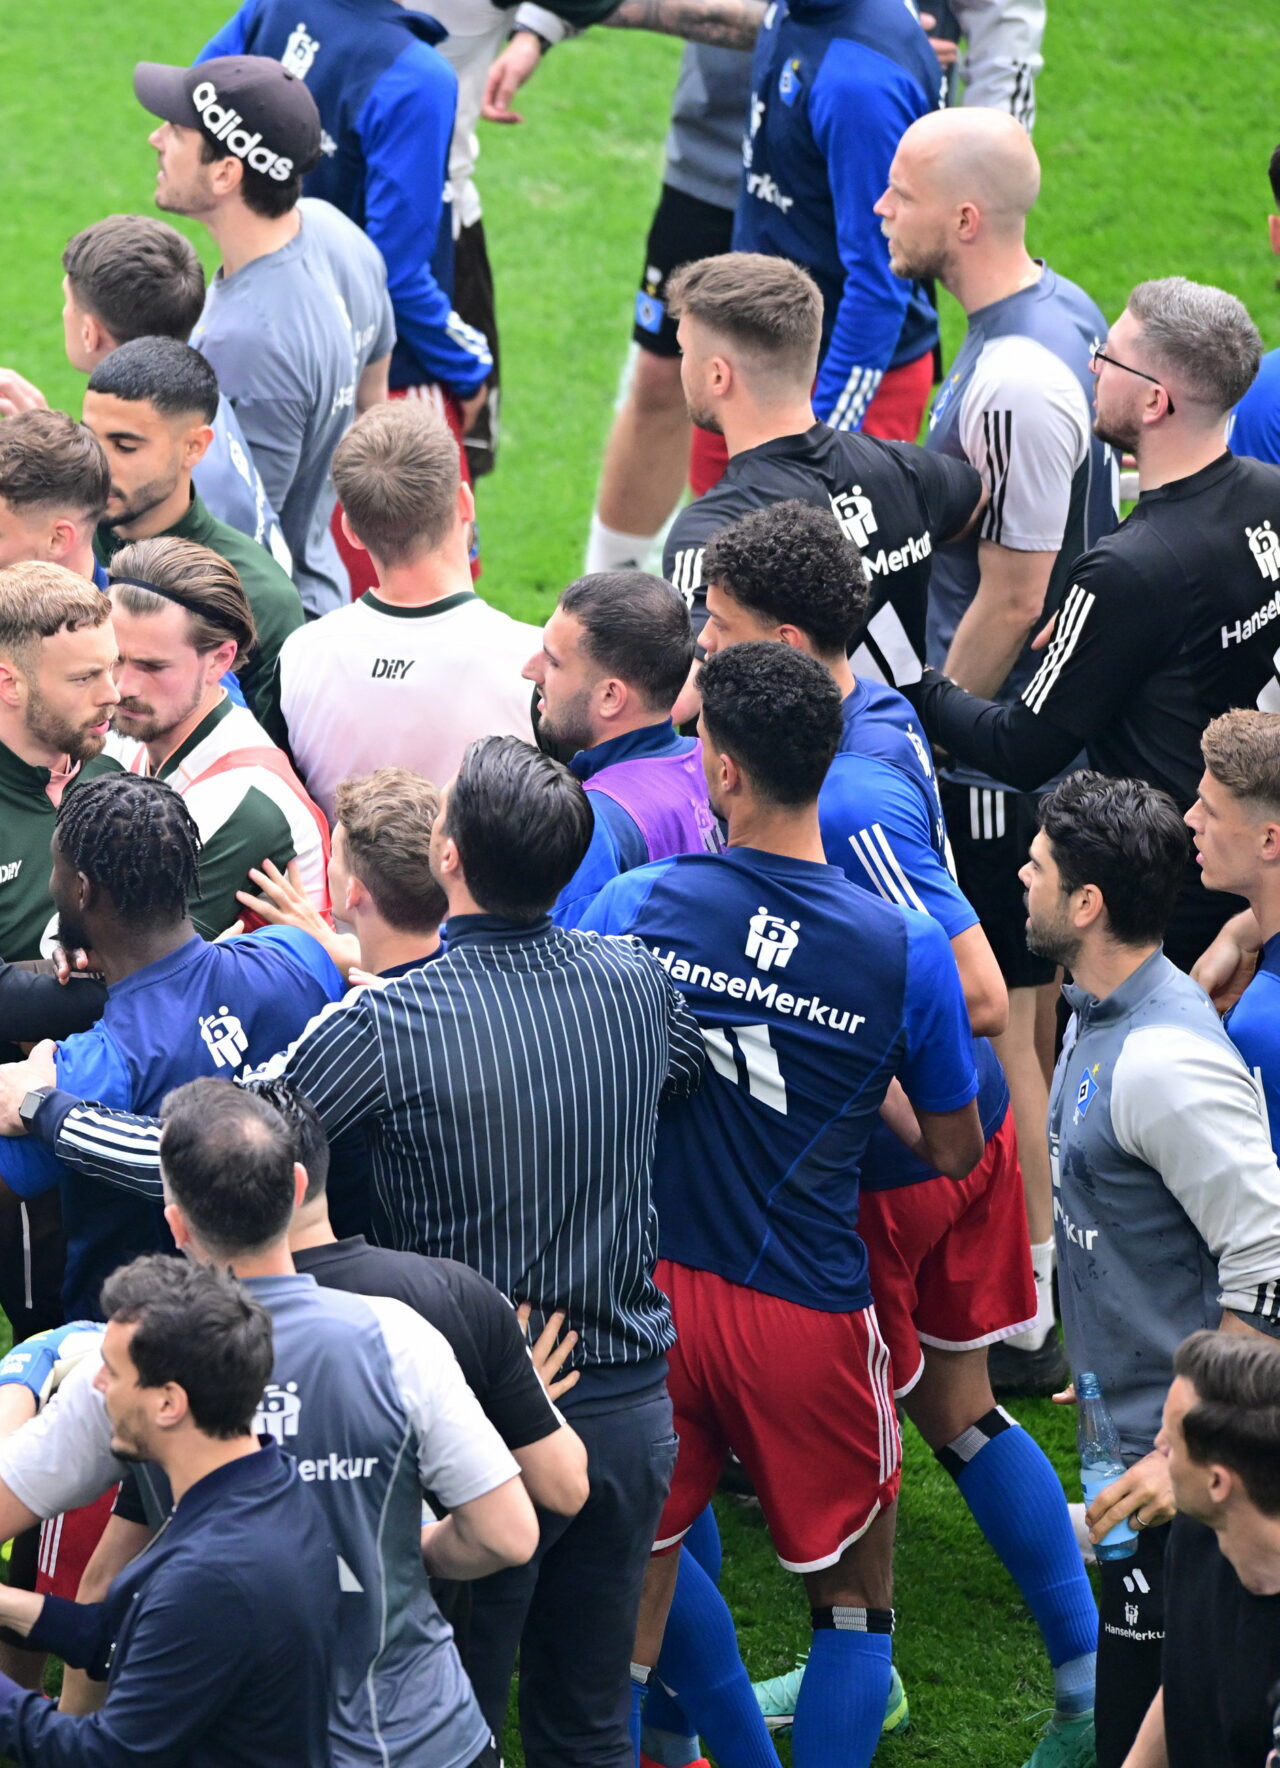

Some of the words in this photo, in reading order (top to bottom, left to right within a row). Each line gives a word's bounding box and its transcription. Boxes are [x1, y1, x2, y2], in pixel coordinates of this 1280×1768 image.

[192, 81, 294, 181] adidas
[650, 946, 867, 1036] HanseMerkur
[1104, 1622, 1167, 1642] HanseMerku
